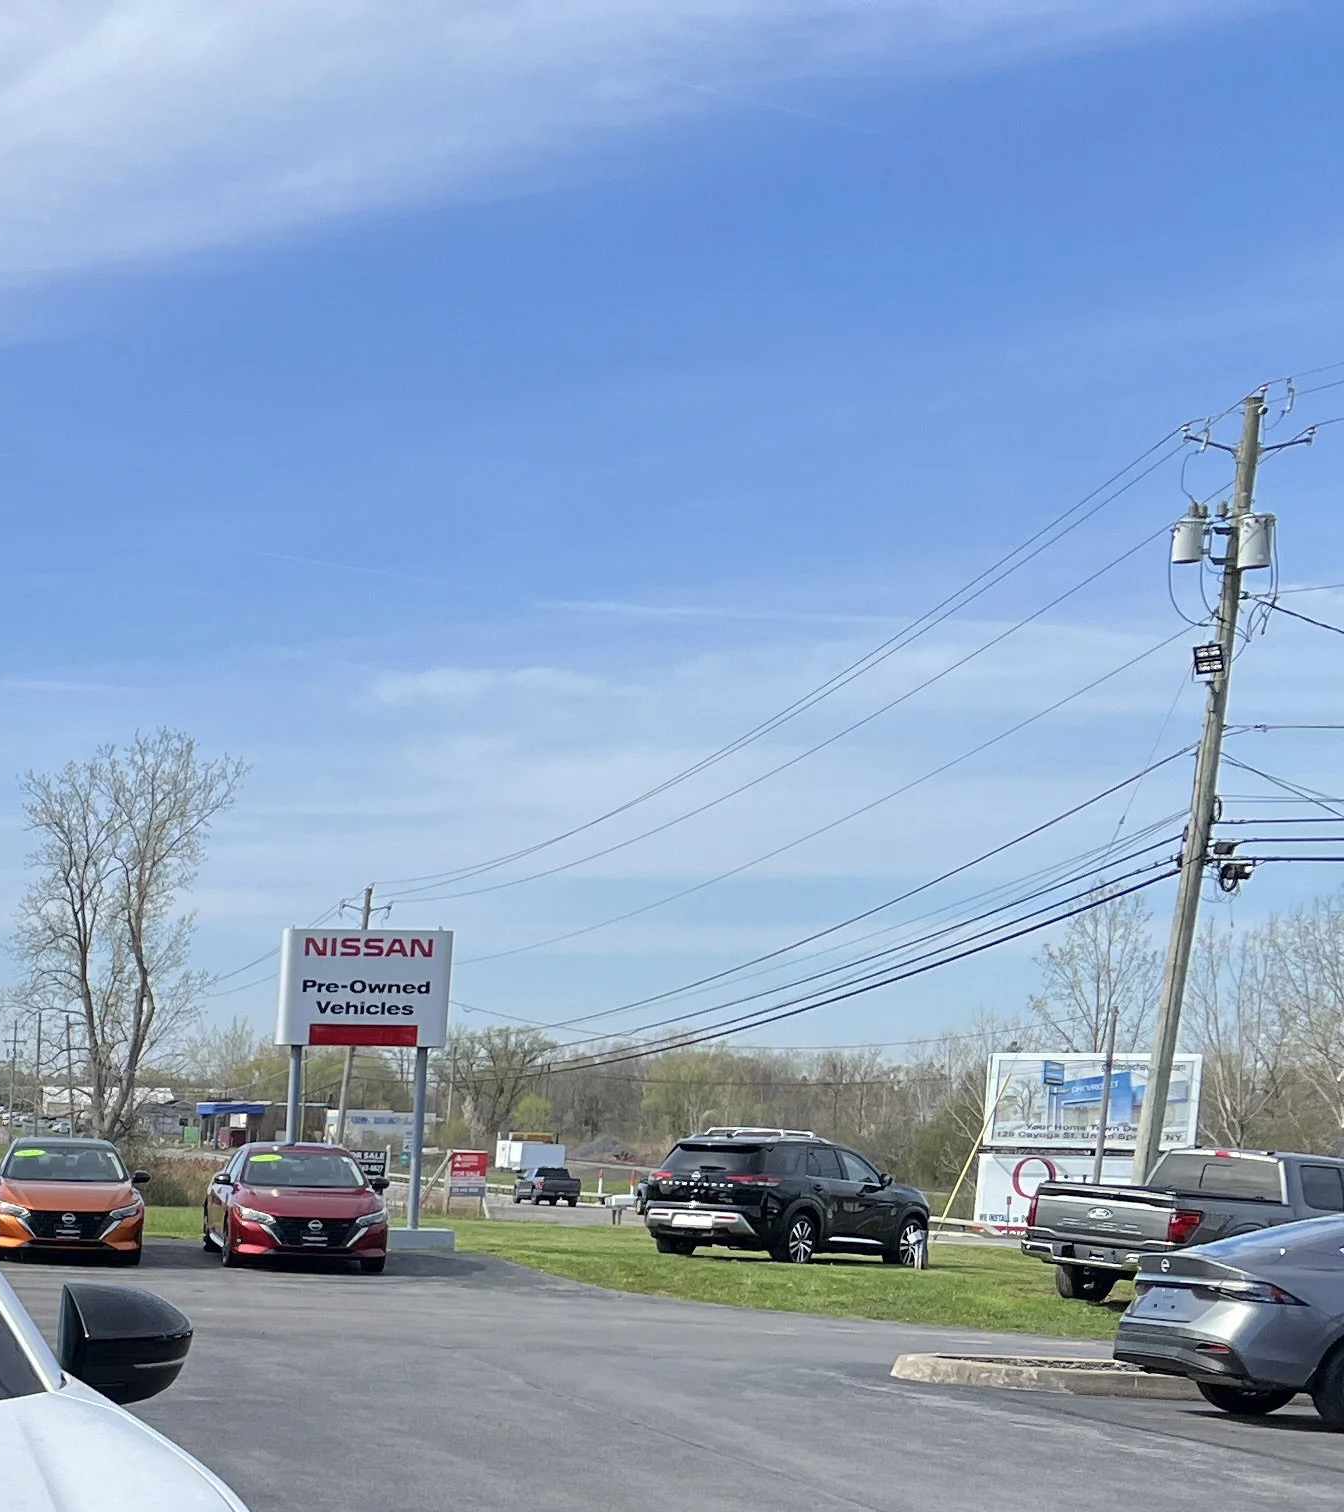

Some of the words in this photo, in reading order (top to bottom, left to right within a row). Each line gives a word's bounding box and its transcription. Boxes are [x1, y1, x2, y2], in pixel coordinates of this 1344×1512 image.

[304, 937, 434, 958] NISSAN
[302, 979, 431, 995] Pre-Owned
[315, 1000, 414, 1016] Vehicles
[1026, 1123, 1052, 1131] Your
[1018, 1131, 1060, 1140] Cayuga
[363, 1151, 385, 1160] SALE
